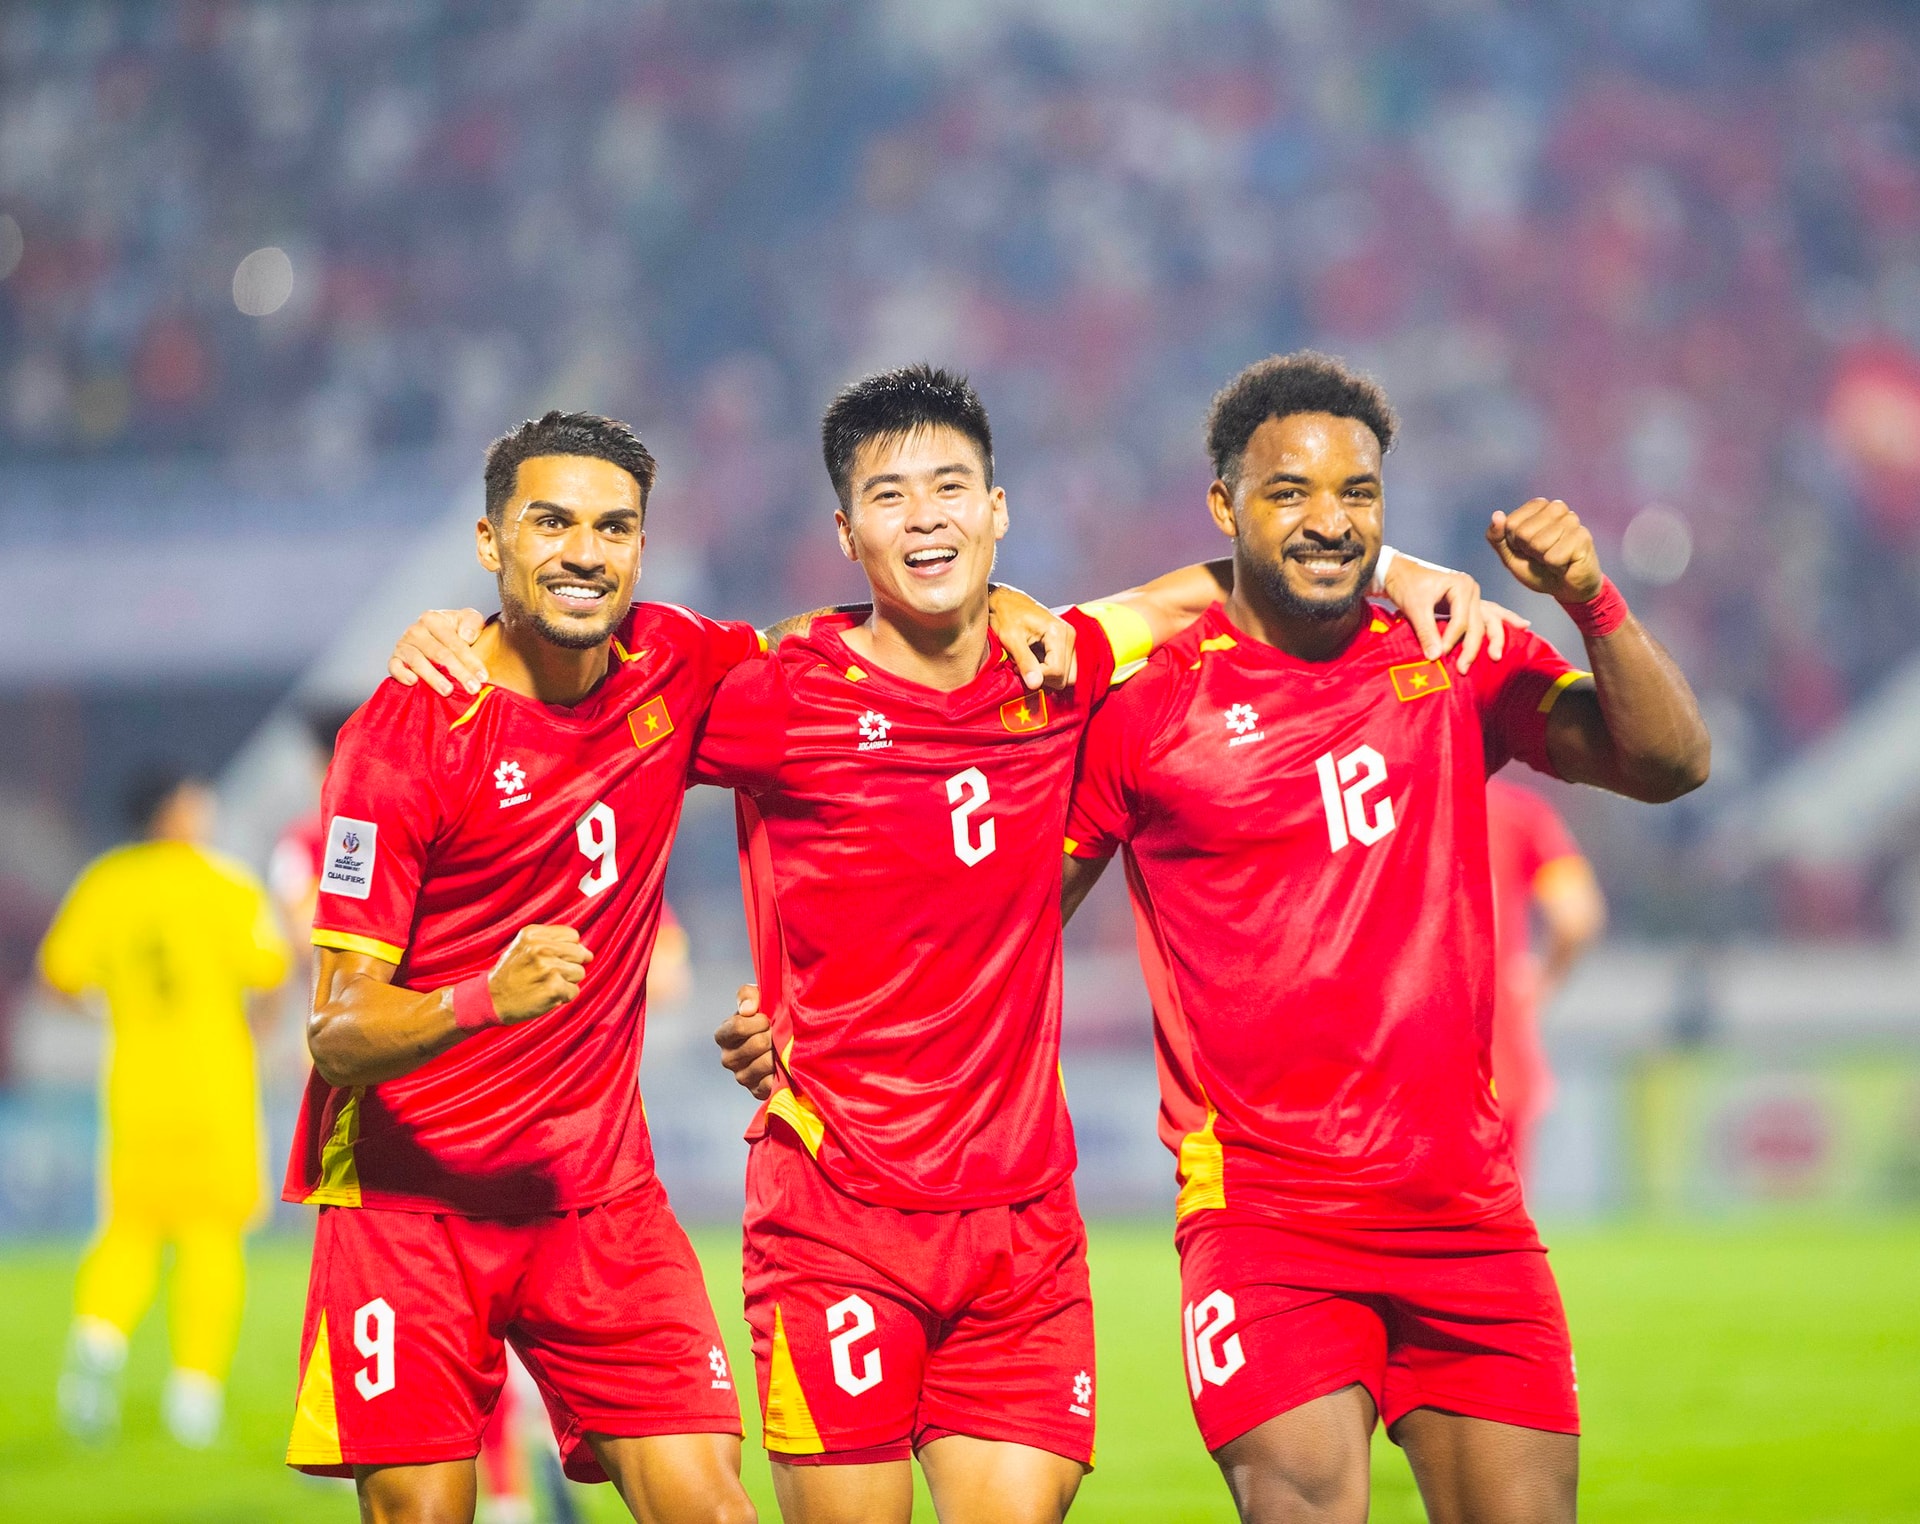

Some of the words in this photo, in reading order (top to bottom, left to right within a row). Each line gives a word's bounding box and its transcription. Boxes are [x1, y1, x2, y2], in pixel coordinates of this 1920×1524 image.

[575, 799, 619, 898] 9
[945, 765, 996, 868] 2
[1315, 744, 1396, 853] 12
[328, 871, 365, 884] QUALIFIERS
[353, 1296, 396, 1402] 9
[825, 1293, 883, 1398] 2
[1183, 1288, 1247, 1401] 12
